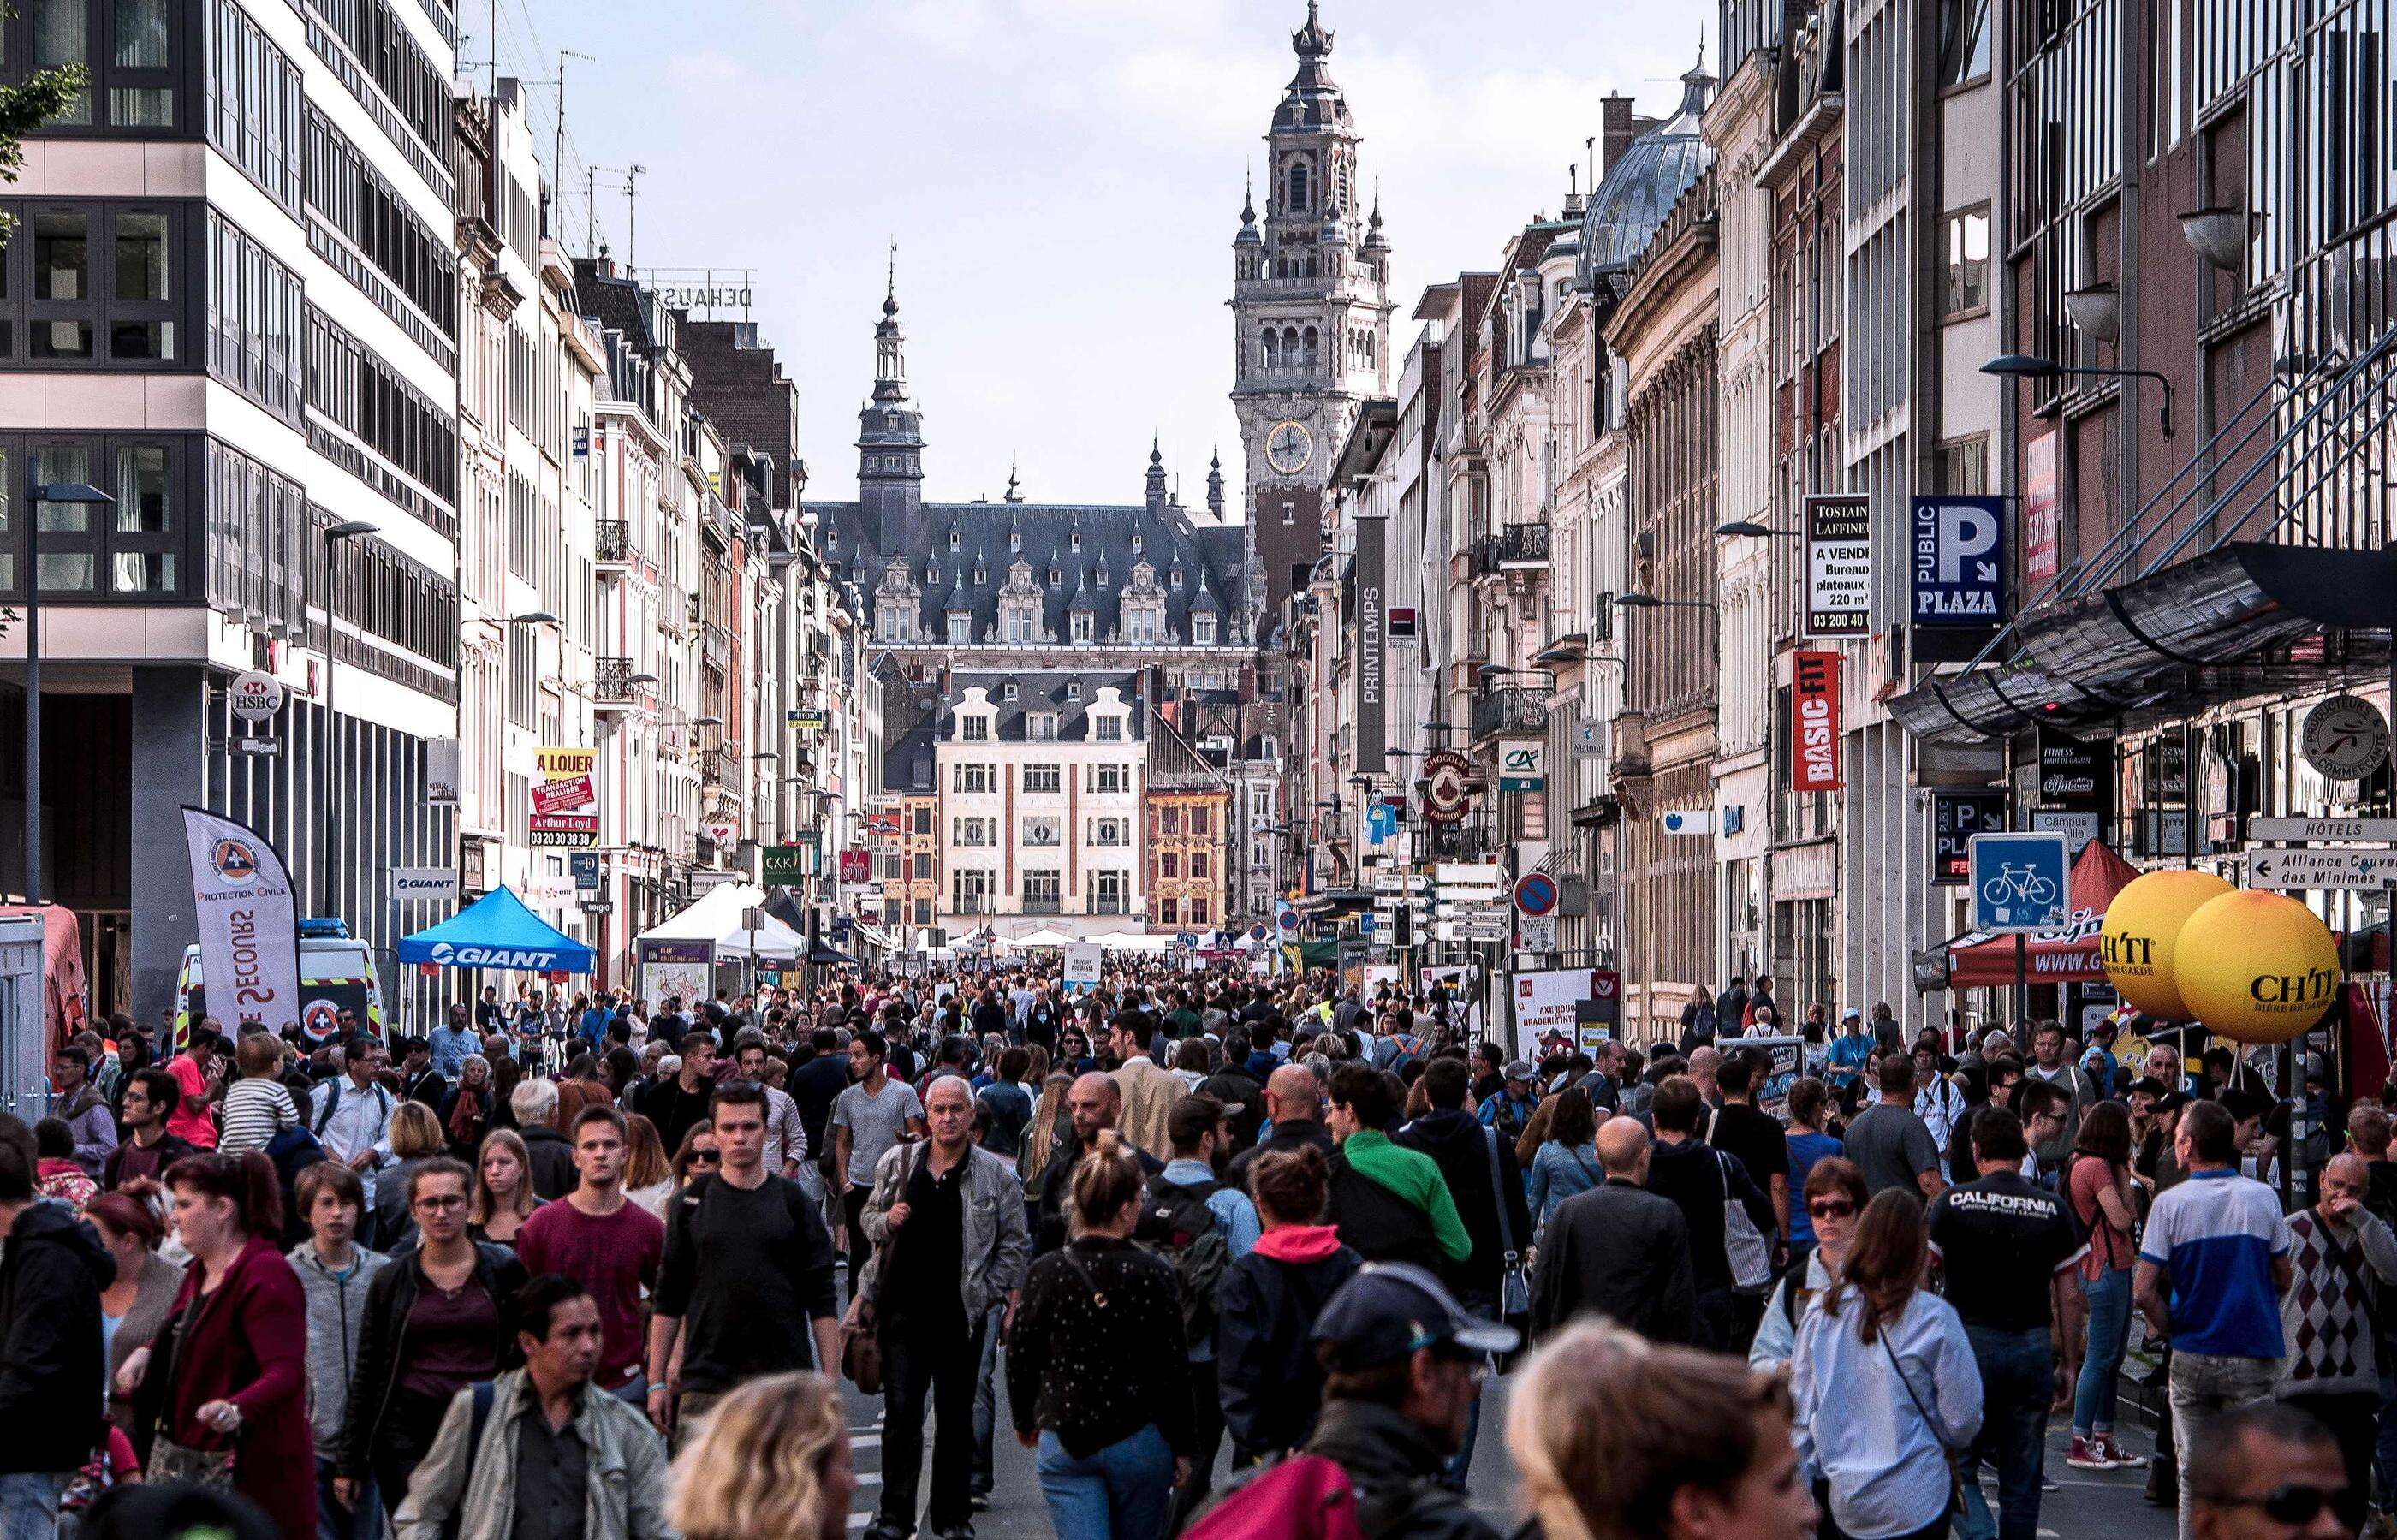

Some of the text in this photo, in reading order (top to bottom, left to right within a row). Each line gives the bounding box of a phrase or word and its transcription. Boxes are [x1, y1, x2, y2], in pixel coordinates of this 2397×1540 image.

[1817, 506, 1868, 519] TOSTAIN
[1918, 506, 1935, 582] PUBLIC
[1939, 506, 1997, 582] P
[1816, 548, 1825, 560] A
[1816, 579, 1865, 593] plateaux
[1829, 594, 1850, 605] 220
[1918, 591, 1997, 614] PLAZA
[1813, 613, 1864, 627] 03 200 40
[1364, 587, 1379, 703] PRINTEMPS
[235, 695, 278, 710] HSBC
[2044, 747, 2073, 758] FITNESS
[537, 754, 593, 773] A LOUER
[1425, 754, 1467, 770] CHOCOLAT
[1939, 800, 1949, 832] PUBLIC
[1957, 805, 1975, 829] P
[2044, 815, 2088, 828] Campus
[535, 817, 592, 831] Arthur Loyd
[2305, 821, 2363, 835] HÔTELS
[531, 832, 590, 845] 03 20 30 38 38
[2281, 854, 2397, 867] Alliance Couve
[842, 866, 868, 881] SPORT
[2281, 871, 2376, 883] des Minimes
[408, 879, 454, 889] GIANT
[197, 886, 287, 902] PROTECTION CIVILE
[2100, 931, 2151, 964] H'TI
[455, 948, 556, 968] GIANT
[2250, 966, 2333, 1002] CH'TI
[1539, 1006, 1555, 1015] AXE
[1949, 1191, 2057, 1216] CALIFORNIA
